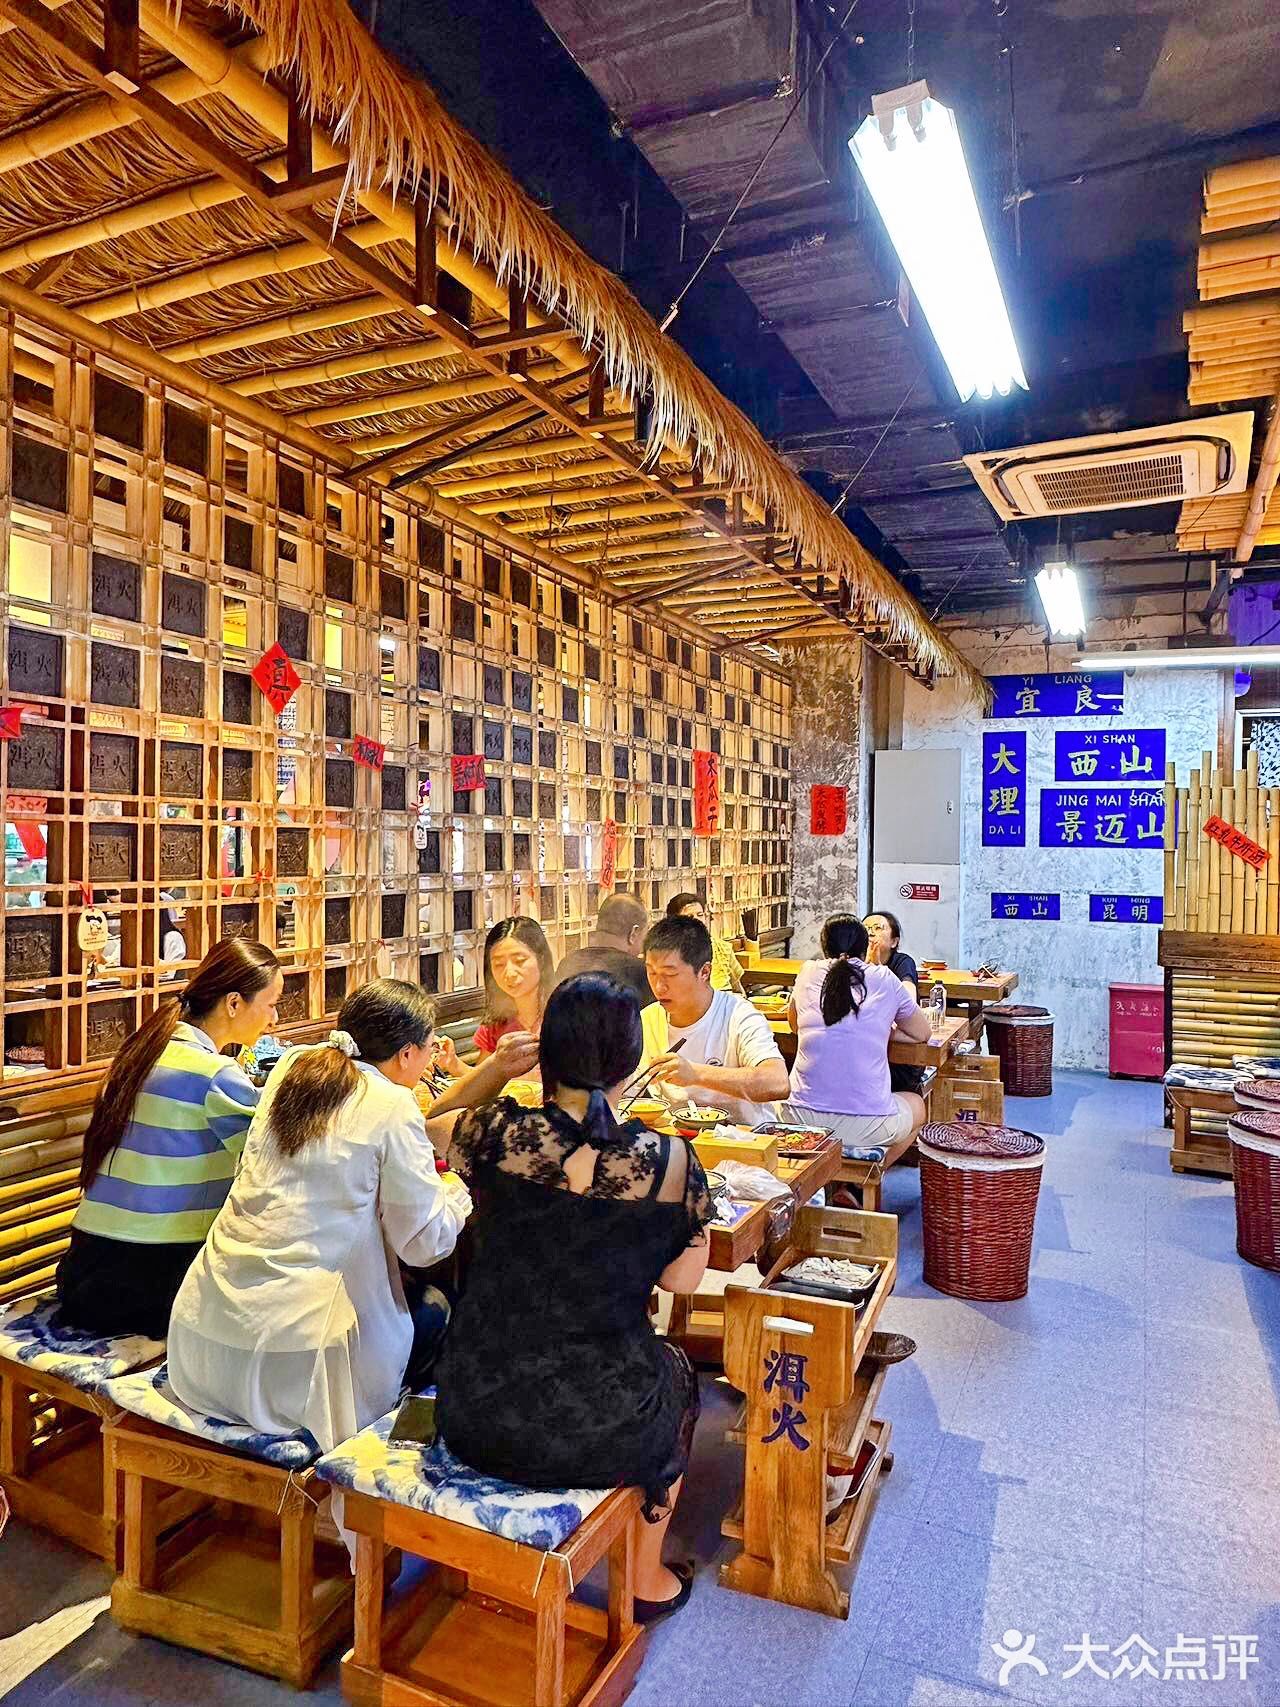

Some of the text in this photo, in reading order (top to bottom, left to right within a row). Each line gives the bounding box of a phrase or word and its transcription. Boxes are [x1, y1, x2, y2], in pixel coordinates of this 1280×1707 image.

[1022, 674, 1092, 686] YI LIANG
[1015, 684, 1101, 715] 宜良
[1084, 734, 1136, 744] XI SHAN
[1067, 744, 1153, 776] 西山
[988, 742, 1021, 816] 大理
[1055, 795, 1089, 807] JING
[1096, 794, 1122, 806] MAI
[988, 825, 1021, 835] DA LI
[1055, 810, 1167, 843] 景迈山
[1004, 903, 1048, 917] 西山
[1102, 904, 1149, 921] 昆明
[761, 1349, 810, 1451] 洱火
